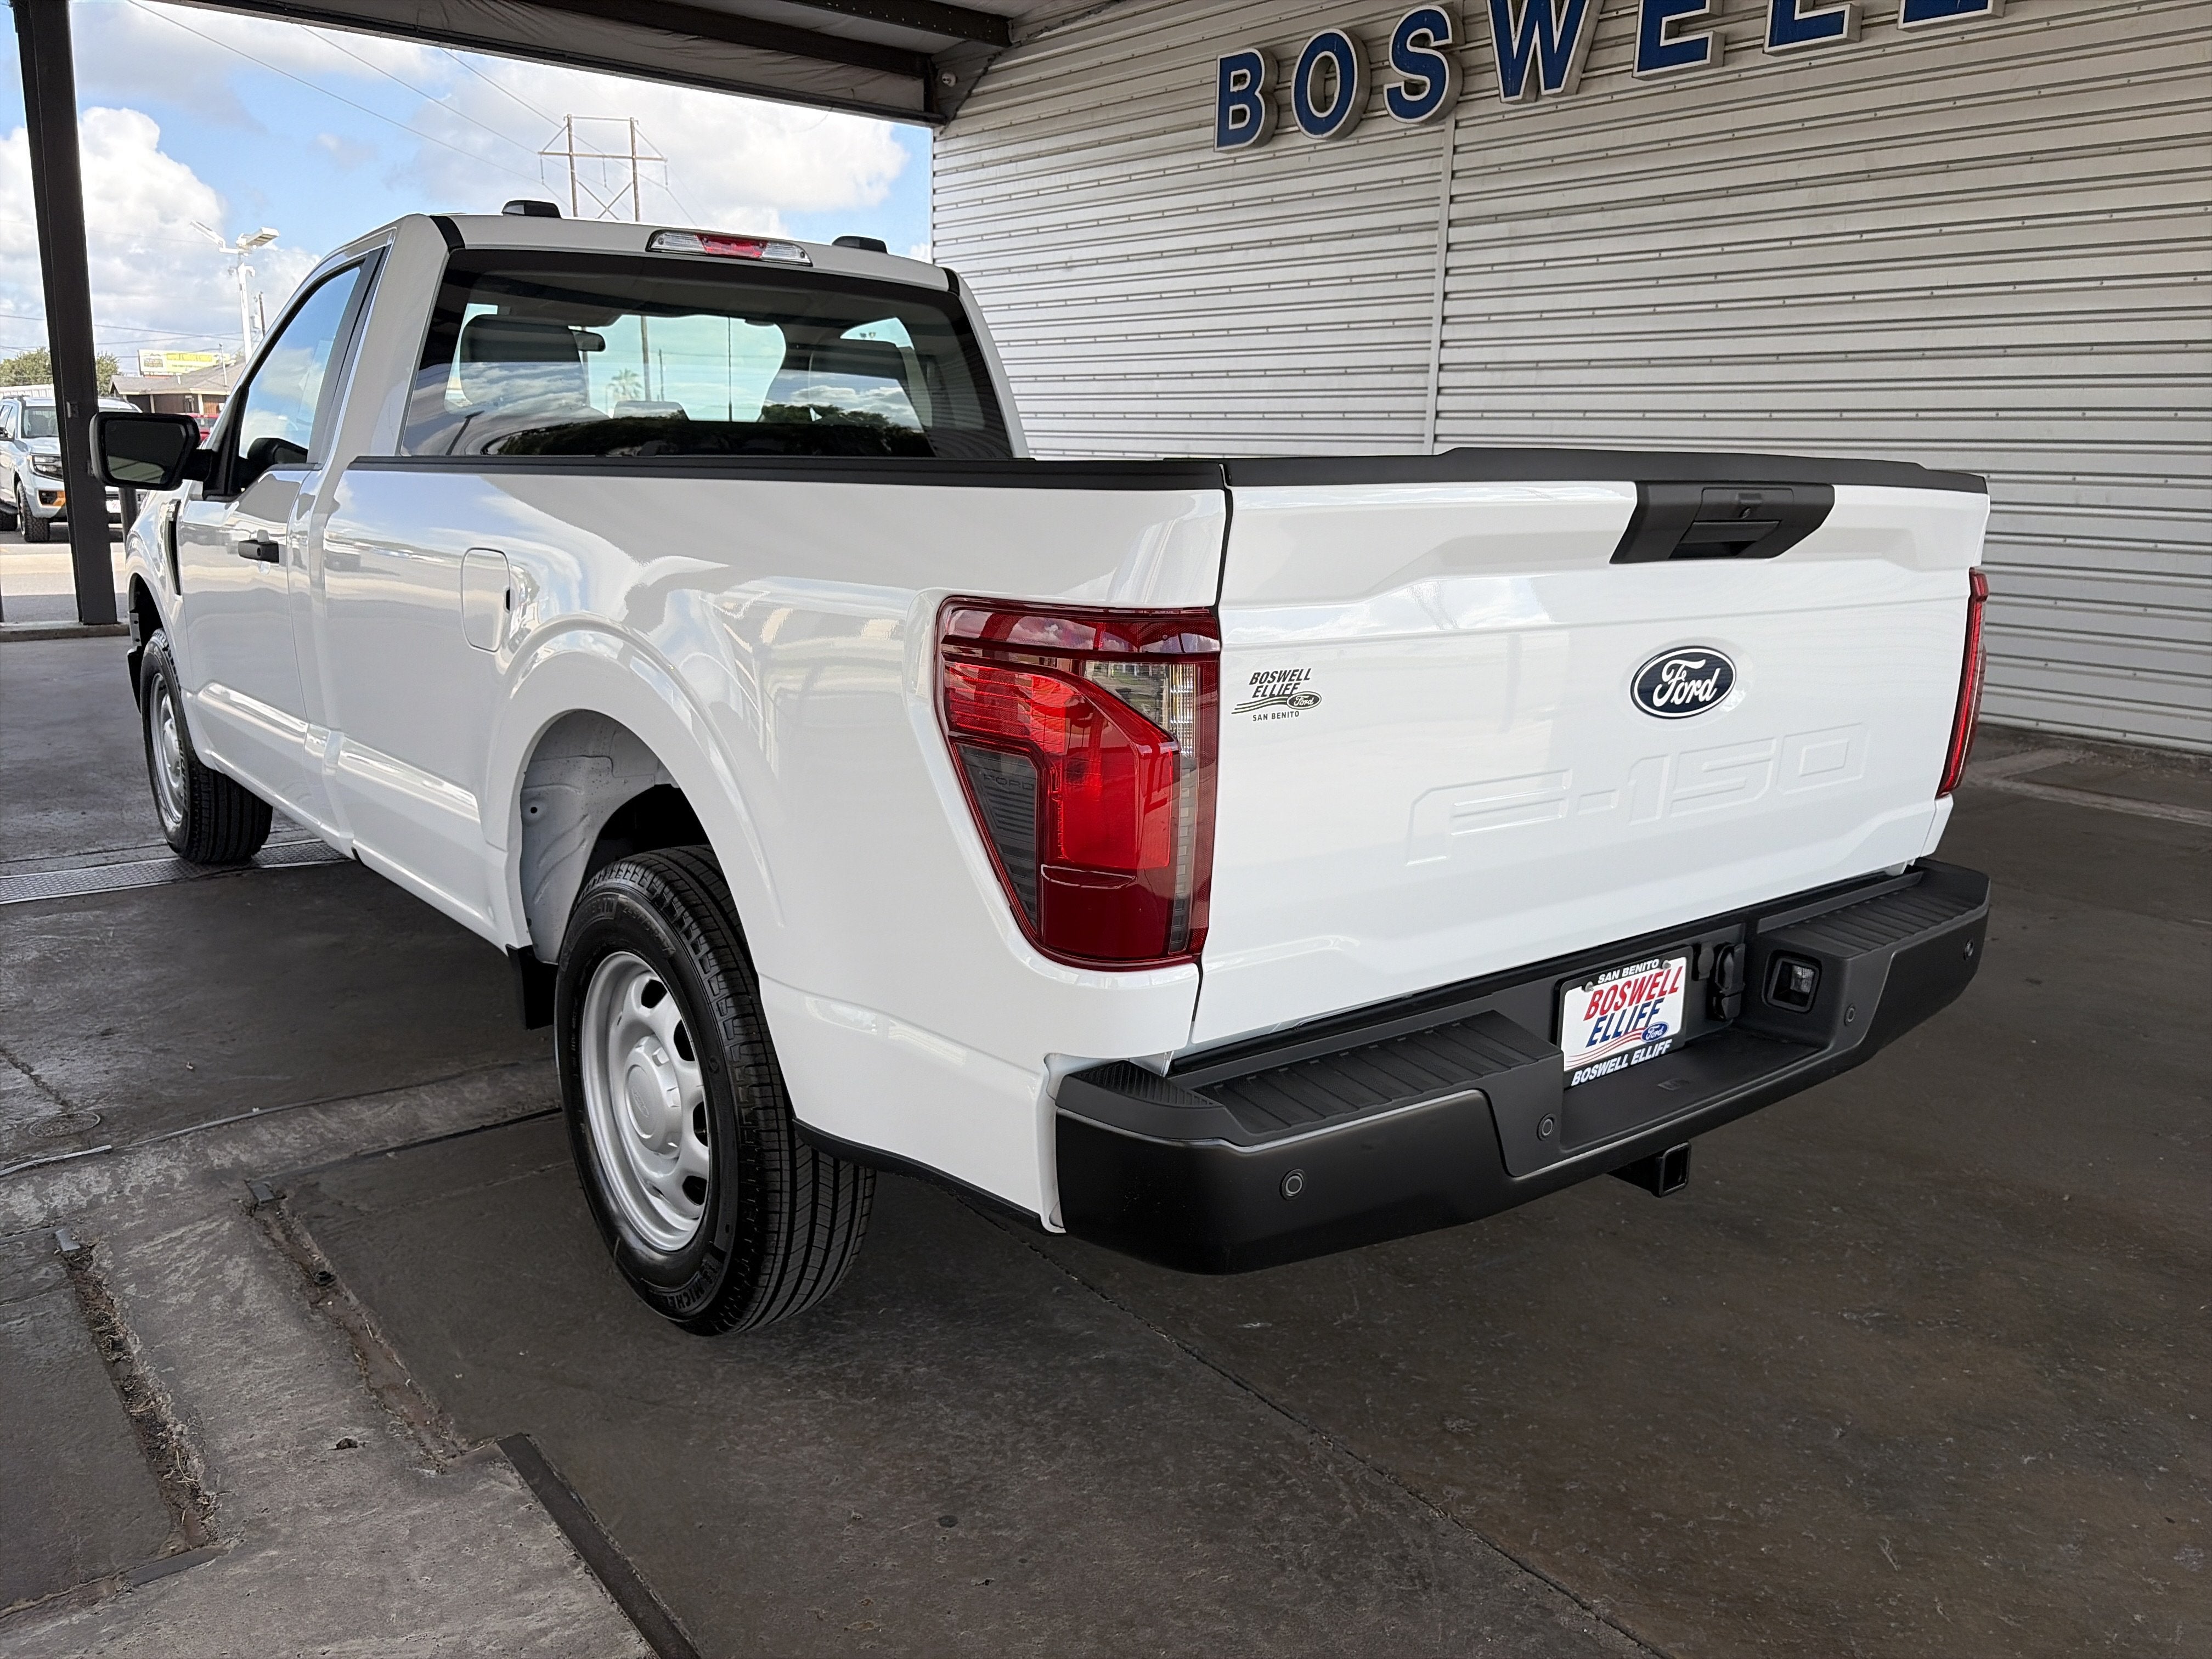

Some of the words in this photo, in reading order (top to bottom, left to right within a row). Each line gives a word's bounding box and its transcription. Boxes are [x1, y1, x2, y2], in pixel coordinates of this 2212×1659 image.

[1213, 0, 2002, 152] BOSWE
[1249, 668, 1311, 685] BOSWELL
[1251, 682, 1301, 698] ELLIFF
[1653, 659, 1720, 707] Ford
[1271, 710, 1300, 720] BENITO
[1293, 695, 1314, 707] Ford
[1406, 721, 1869, 866] F-150
[1598, 969, 1620, 984] SAN
[1622, 958, 1660, 977] BENITO
[1583, 966, 1683, 1021] BOSWELL
[1585, 997, 1664, 1048] ELLIFF
[1645, 1025, 1663, 1040] Ford
[1571, 1053, 1629, 1086] BOSWELL
[1630, 1039, 1673, 1066] ELLIFF
